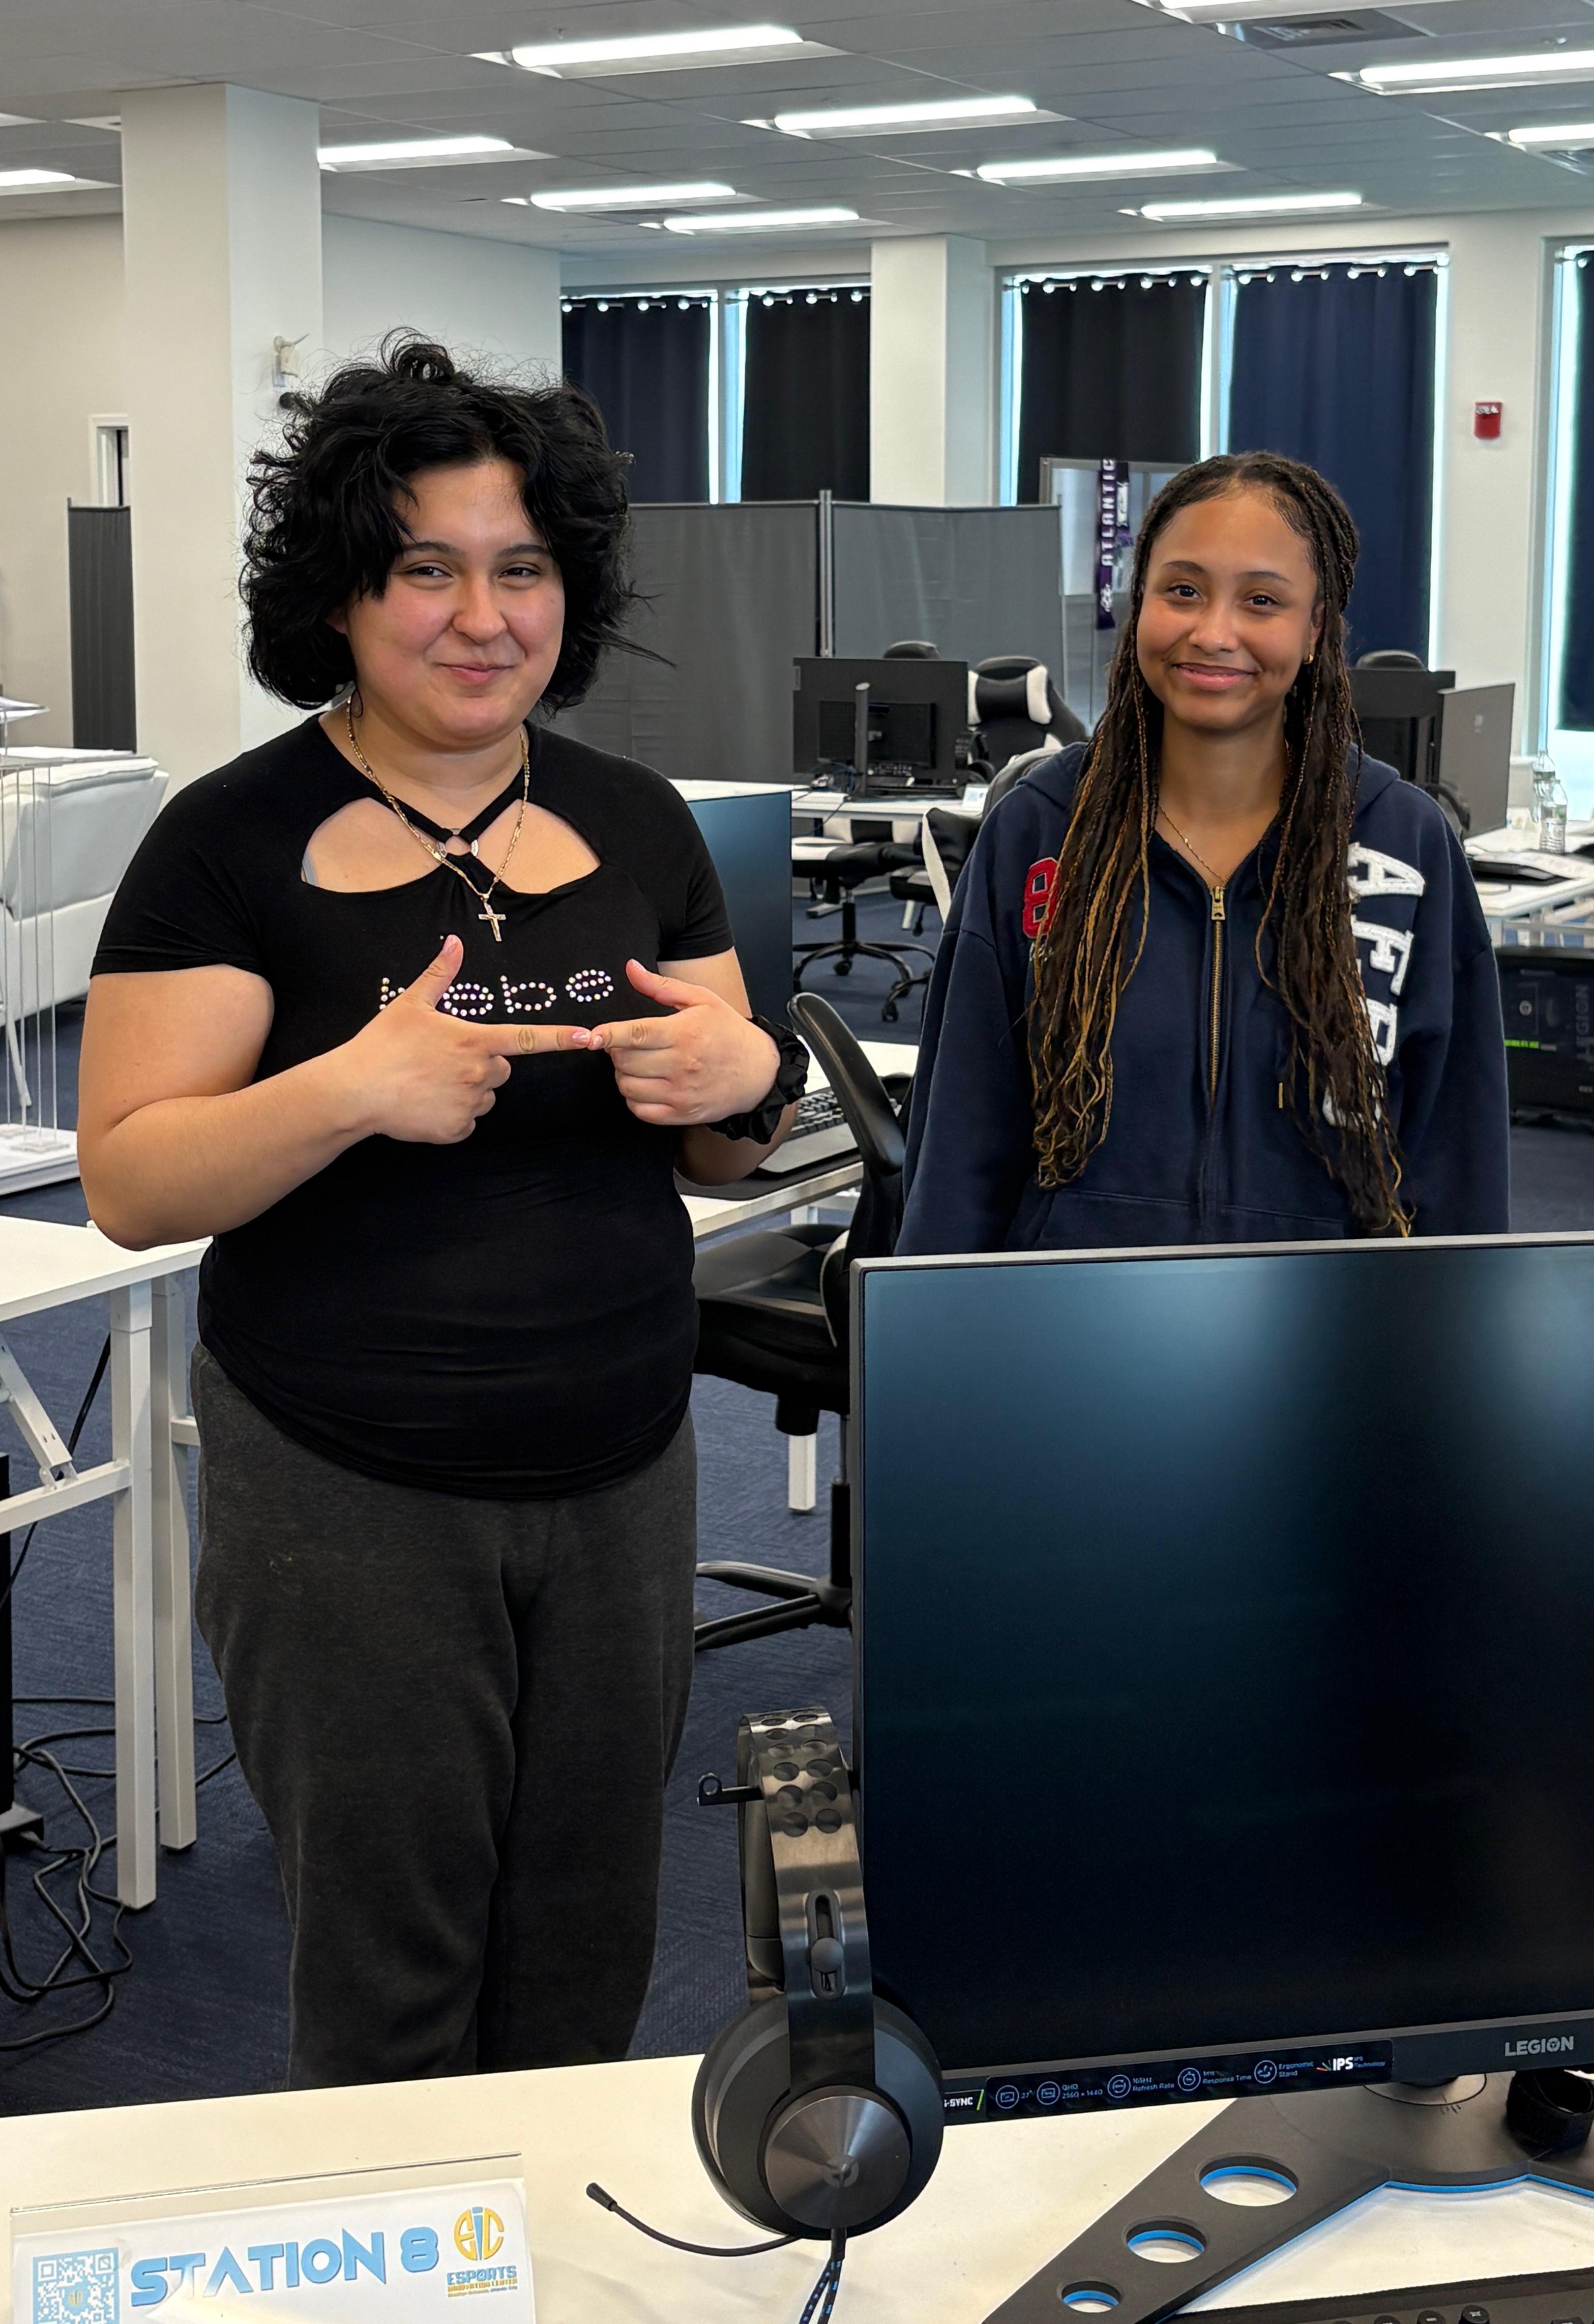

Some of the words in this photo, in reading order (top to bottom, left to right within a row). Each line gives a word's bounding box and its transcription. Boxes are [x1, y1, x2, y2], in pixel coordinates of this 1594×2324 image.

[1505, 2036, 1574, 2056] LEGION
[1333, 2056, 1354, 2071] IPS
[131, 2228, 387, 2307] STATION
[400, 2226, 439, 2273] 8
[447, 2265, 517, 2286] ESPORTS
